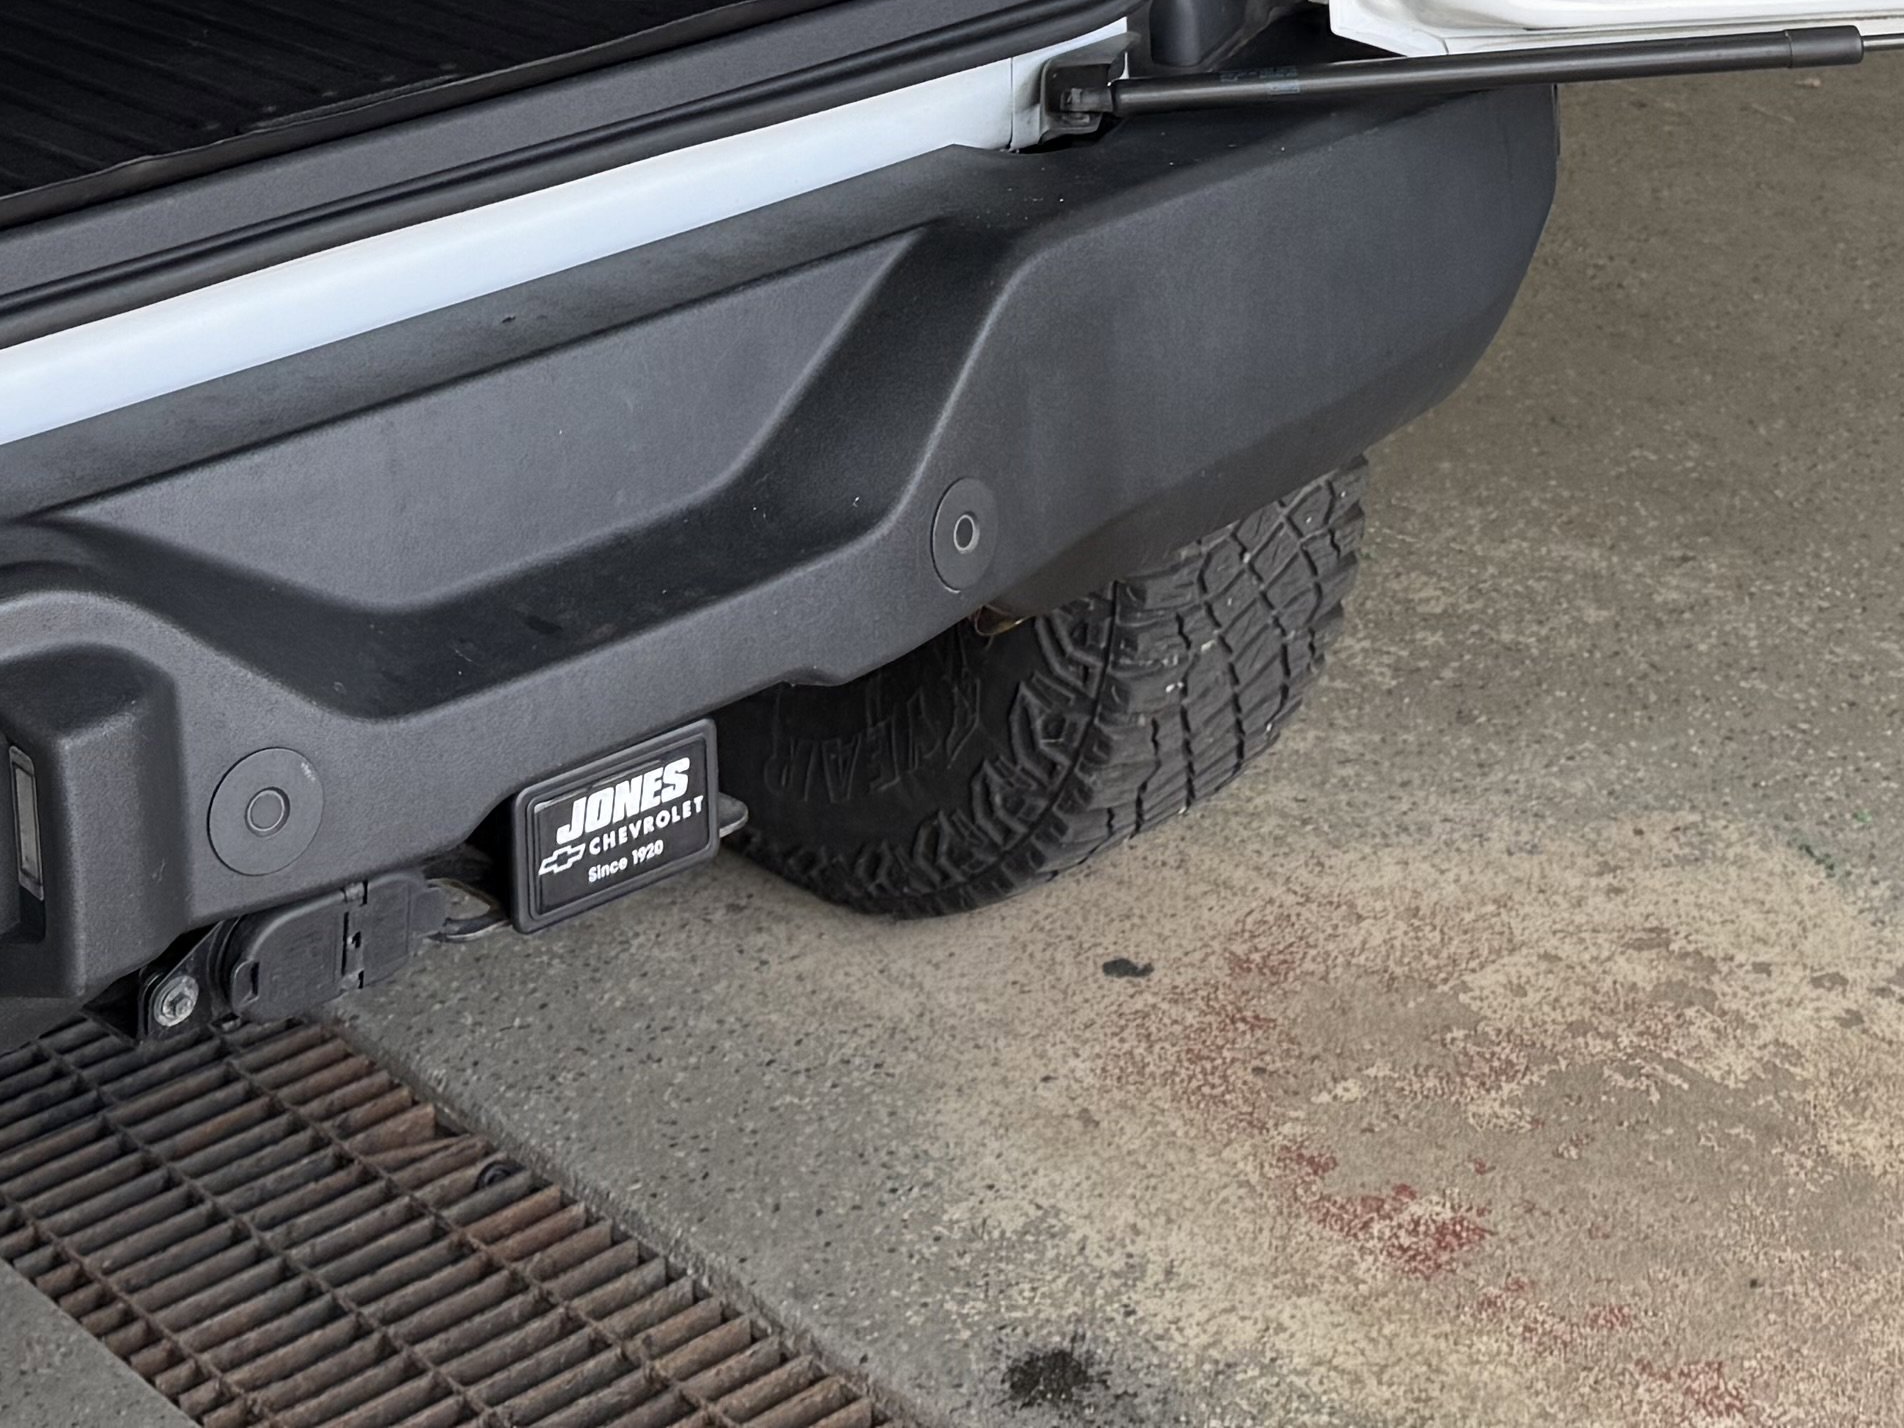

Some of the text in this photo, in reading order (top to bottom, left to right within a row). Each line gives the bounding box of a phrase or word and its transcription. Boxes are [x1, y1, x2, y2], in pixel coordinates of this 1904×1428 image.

[556, 756, 691, 844] JONES
[588, 795, 704, 856] CHEVROLET
[587, 838, 665, 884] Since 1920
